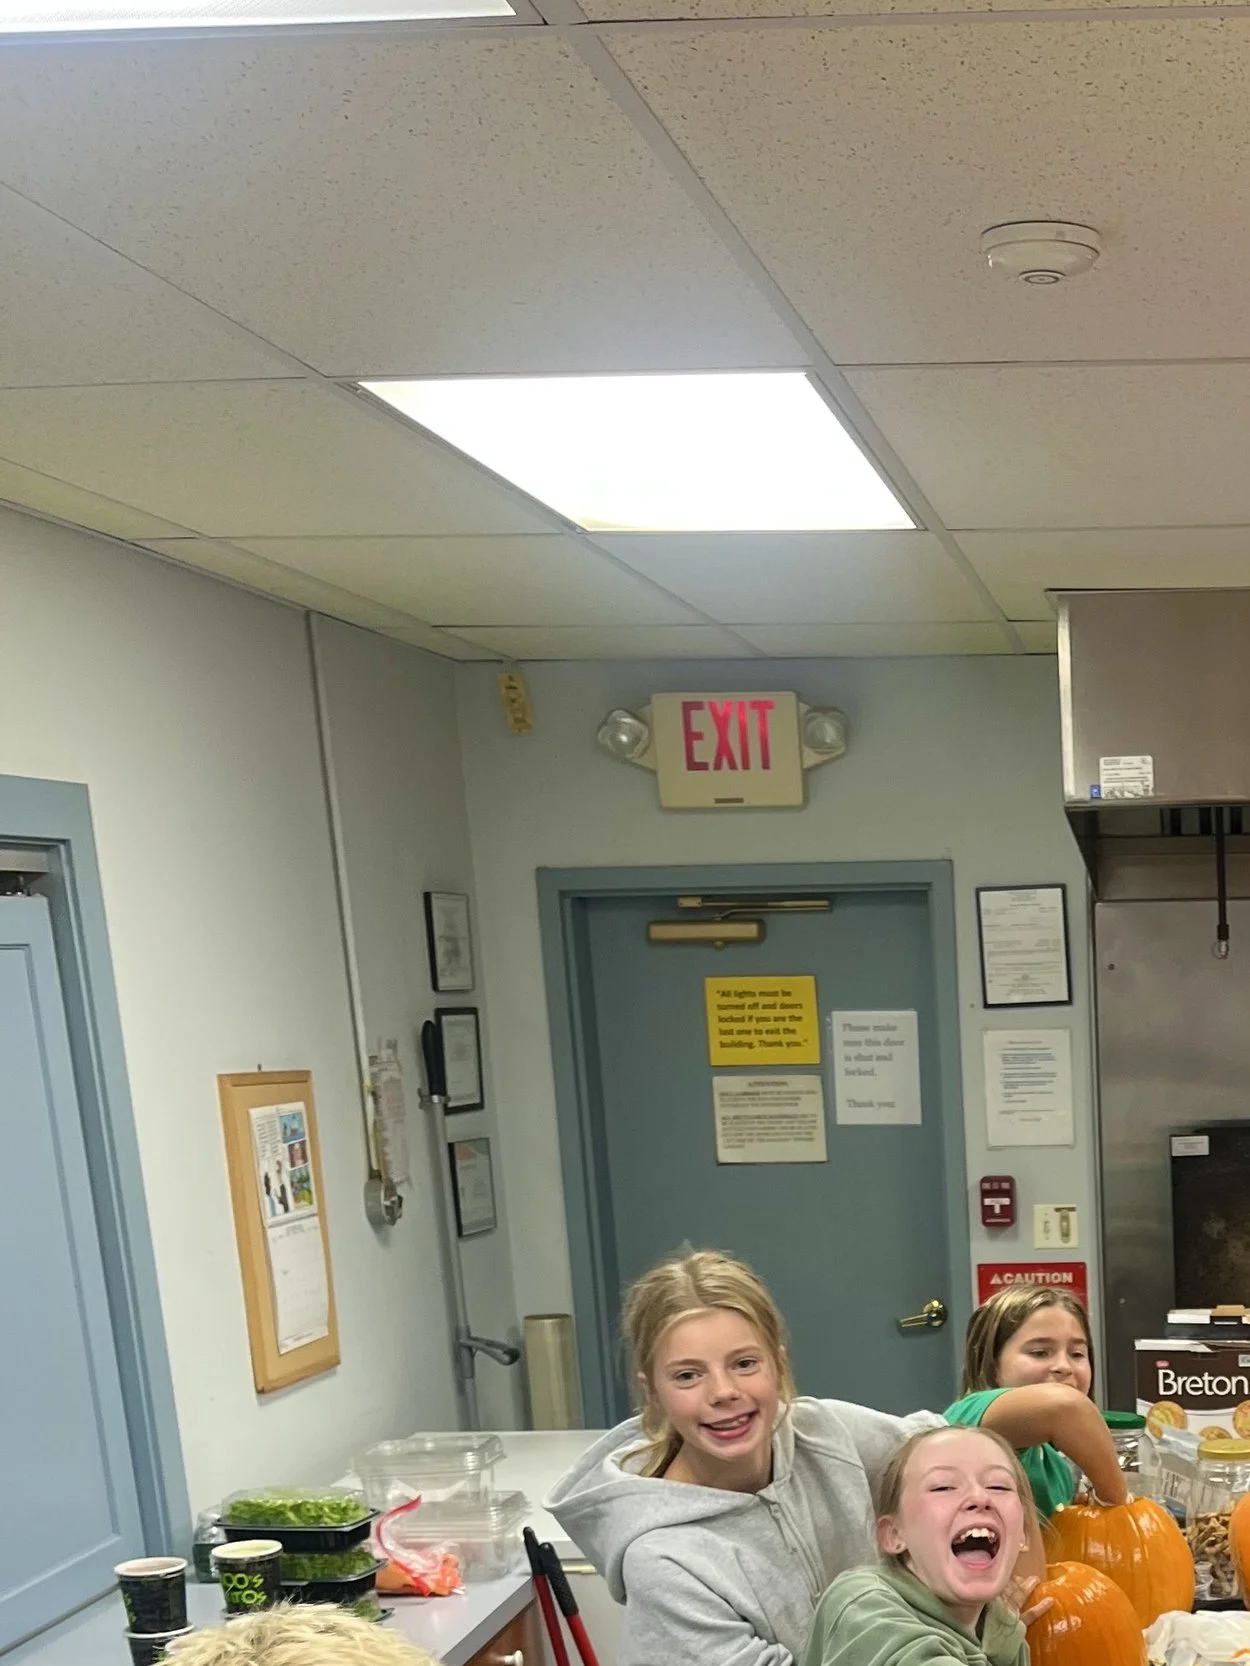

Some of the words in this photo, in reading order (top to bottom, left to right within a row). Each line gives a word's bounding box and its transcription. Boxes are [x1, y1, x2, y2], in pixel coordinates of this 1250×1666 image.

[681, 699, 775, 771] EXIT
[734, 988, 756, 999] lights
[781, 989, 792, 997] be
[747, 1002, 759, 1010] off
[756, 1016, 771, 1024] you
[788, 1014, 802, 1022] the
[843, 1023, 870, 1032] Please
[873, 1023, 897, 1031] make
[865, 1038, 881, 1046] this
[883, 1037, 904, 1046] door
[875, 1052, 893, 1061] and
[847, 1099, 874, 1107] Thank
[1004, 1272, 1073, 1284] CAUTION
[1157, 1369, 1249, 1396] Breton
